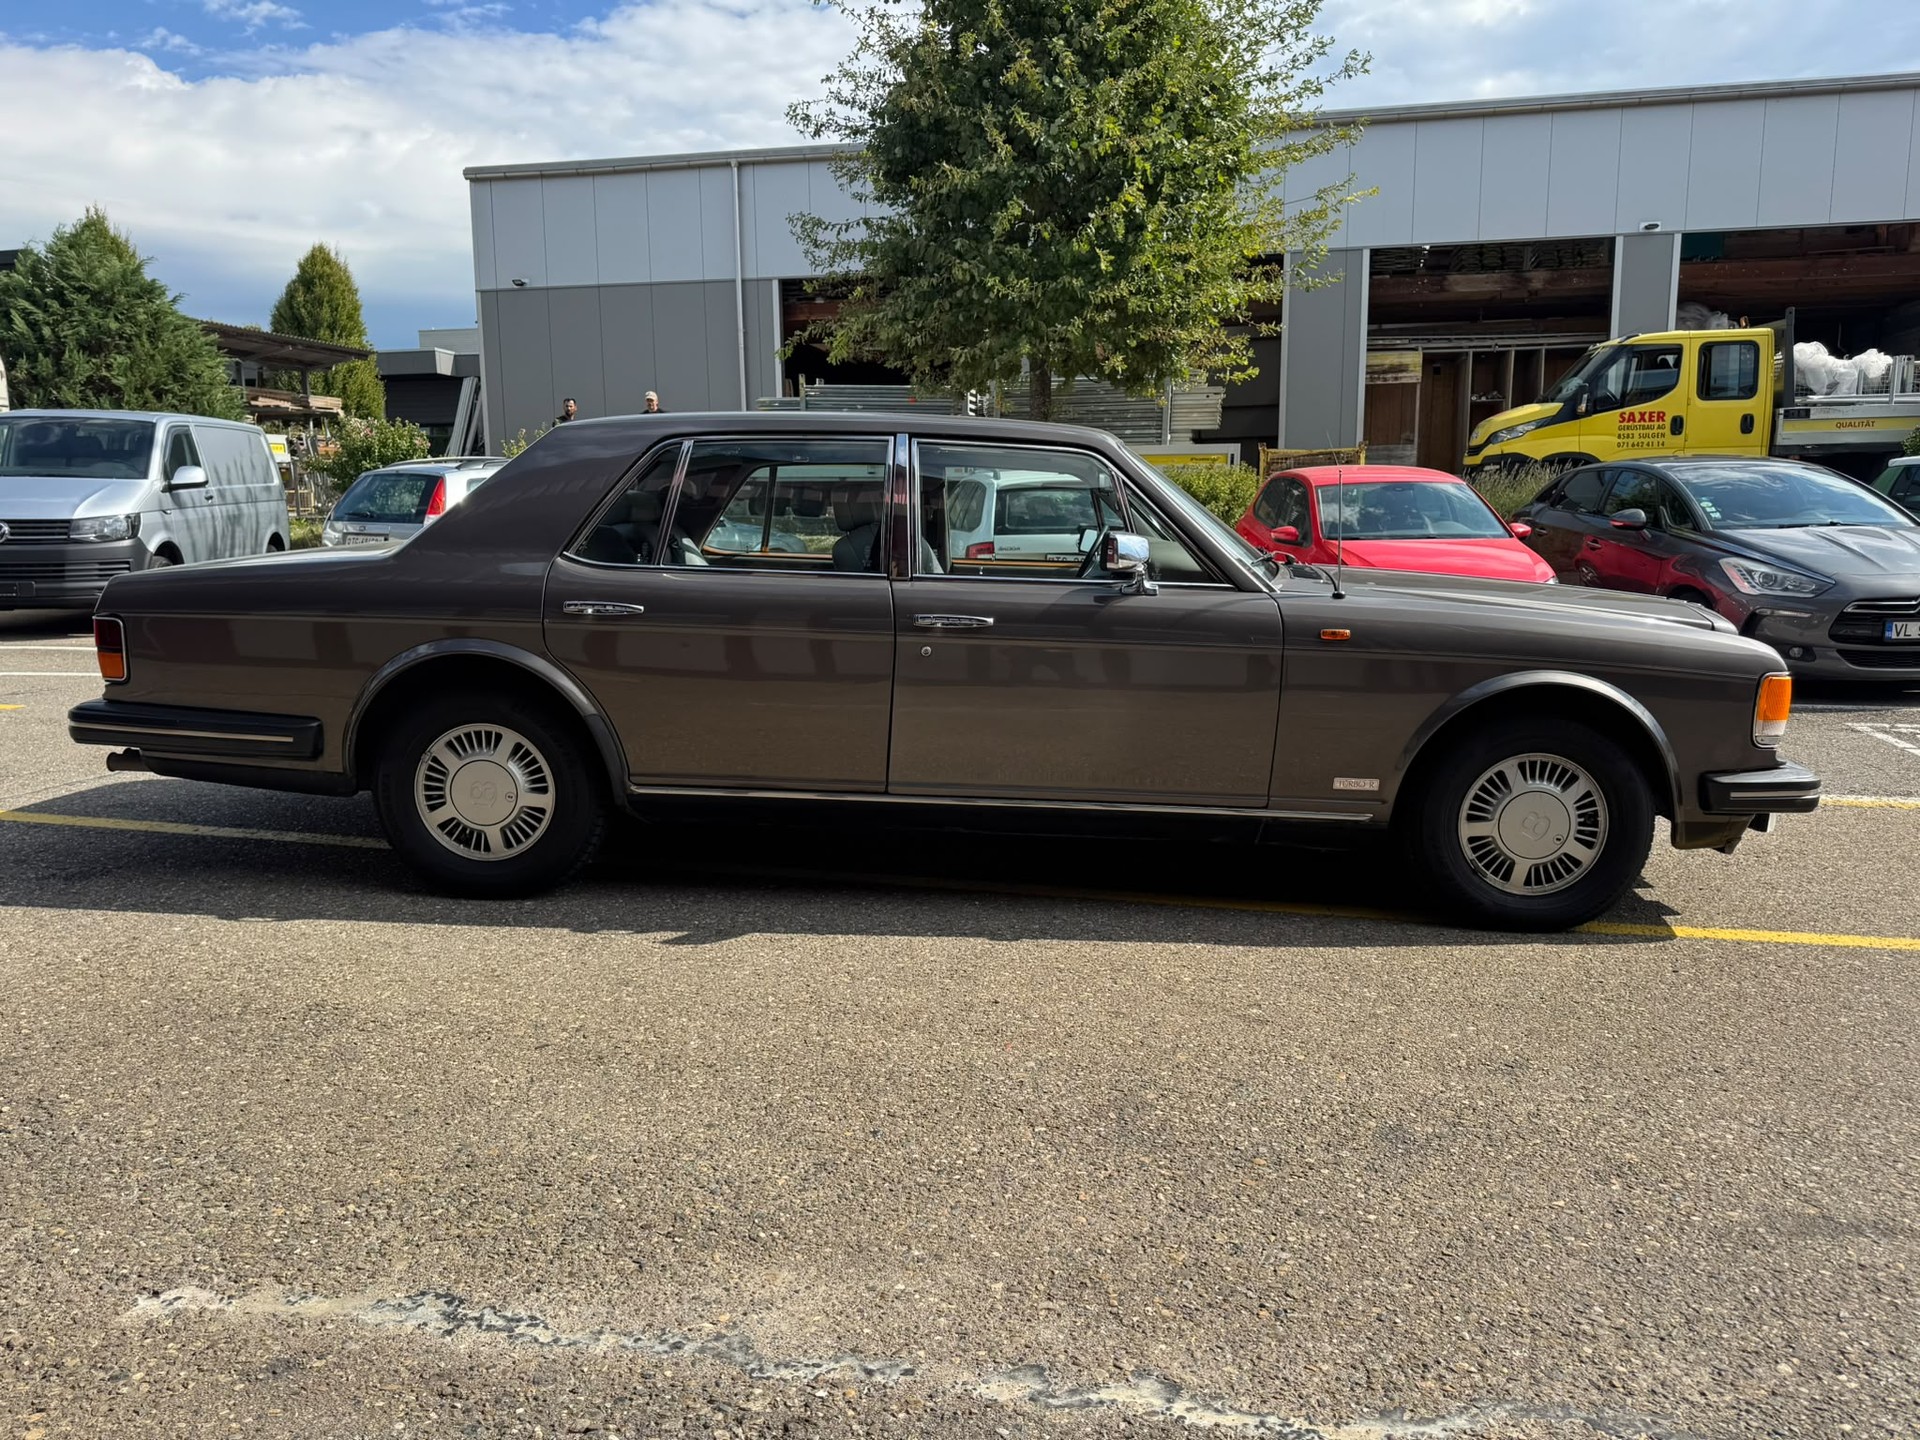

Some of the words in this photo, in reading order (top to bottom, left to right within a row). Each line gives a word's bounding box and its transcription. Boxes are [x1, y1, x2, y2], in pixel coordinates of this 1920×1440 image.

[1618, 411, 1666, 423] SAXER
[1836, 420, 1876, 429] QUALITÄT
[1894, 623, 1912, 637] VL
[1338, 780, 1366, 788] TURBO
